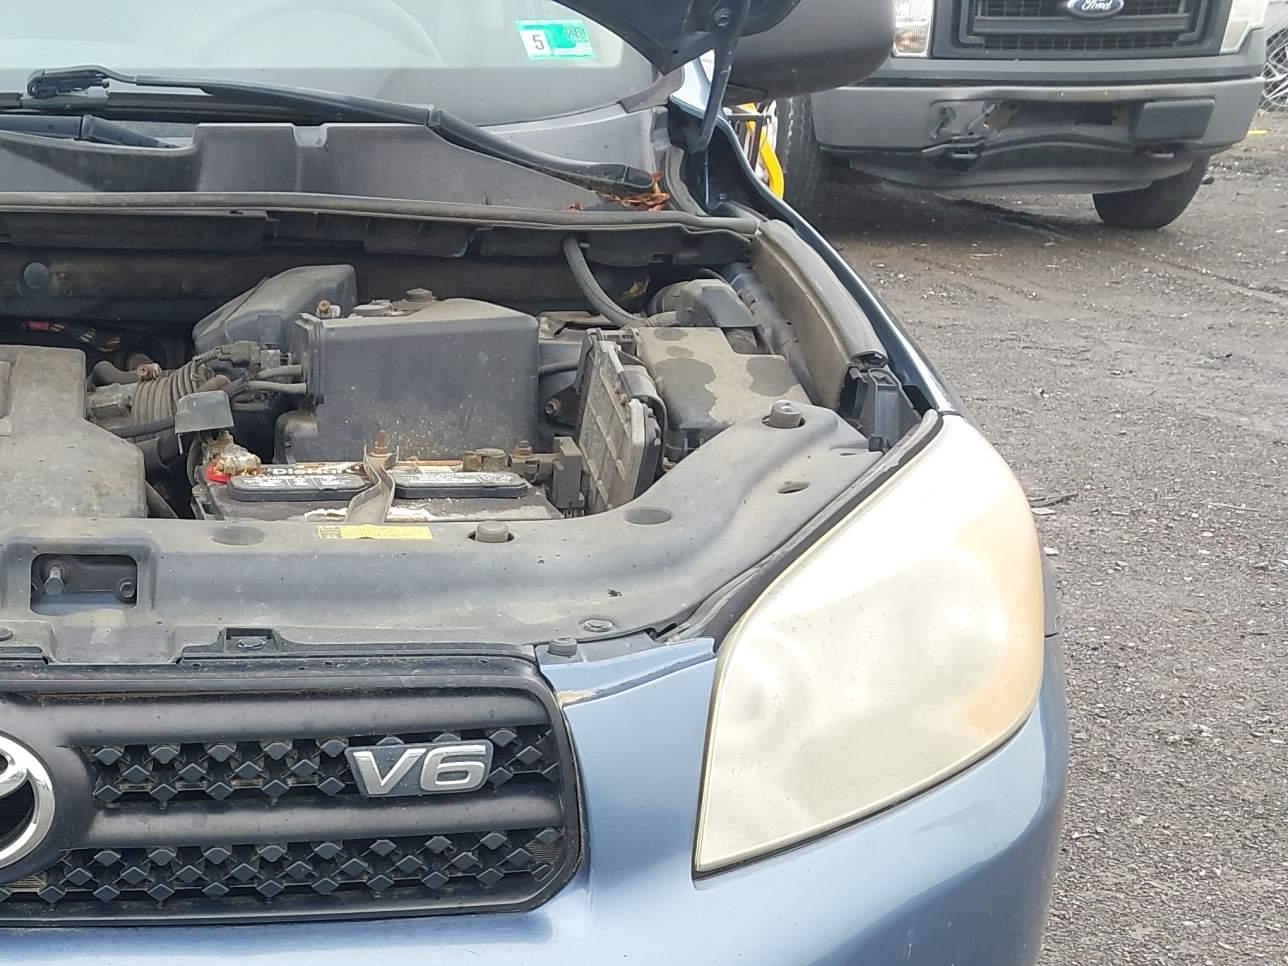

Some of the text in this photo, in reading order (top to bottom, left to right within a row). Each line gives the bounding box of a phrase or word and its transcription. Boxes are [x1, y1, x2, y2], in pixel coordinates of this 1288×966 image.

[1081, 0, 1113, 11] Ford
[532, 33, 545, 50] 5
[353, 744, 487, 795] V6
